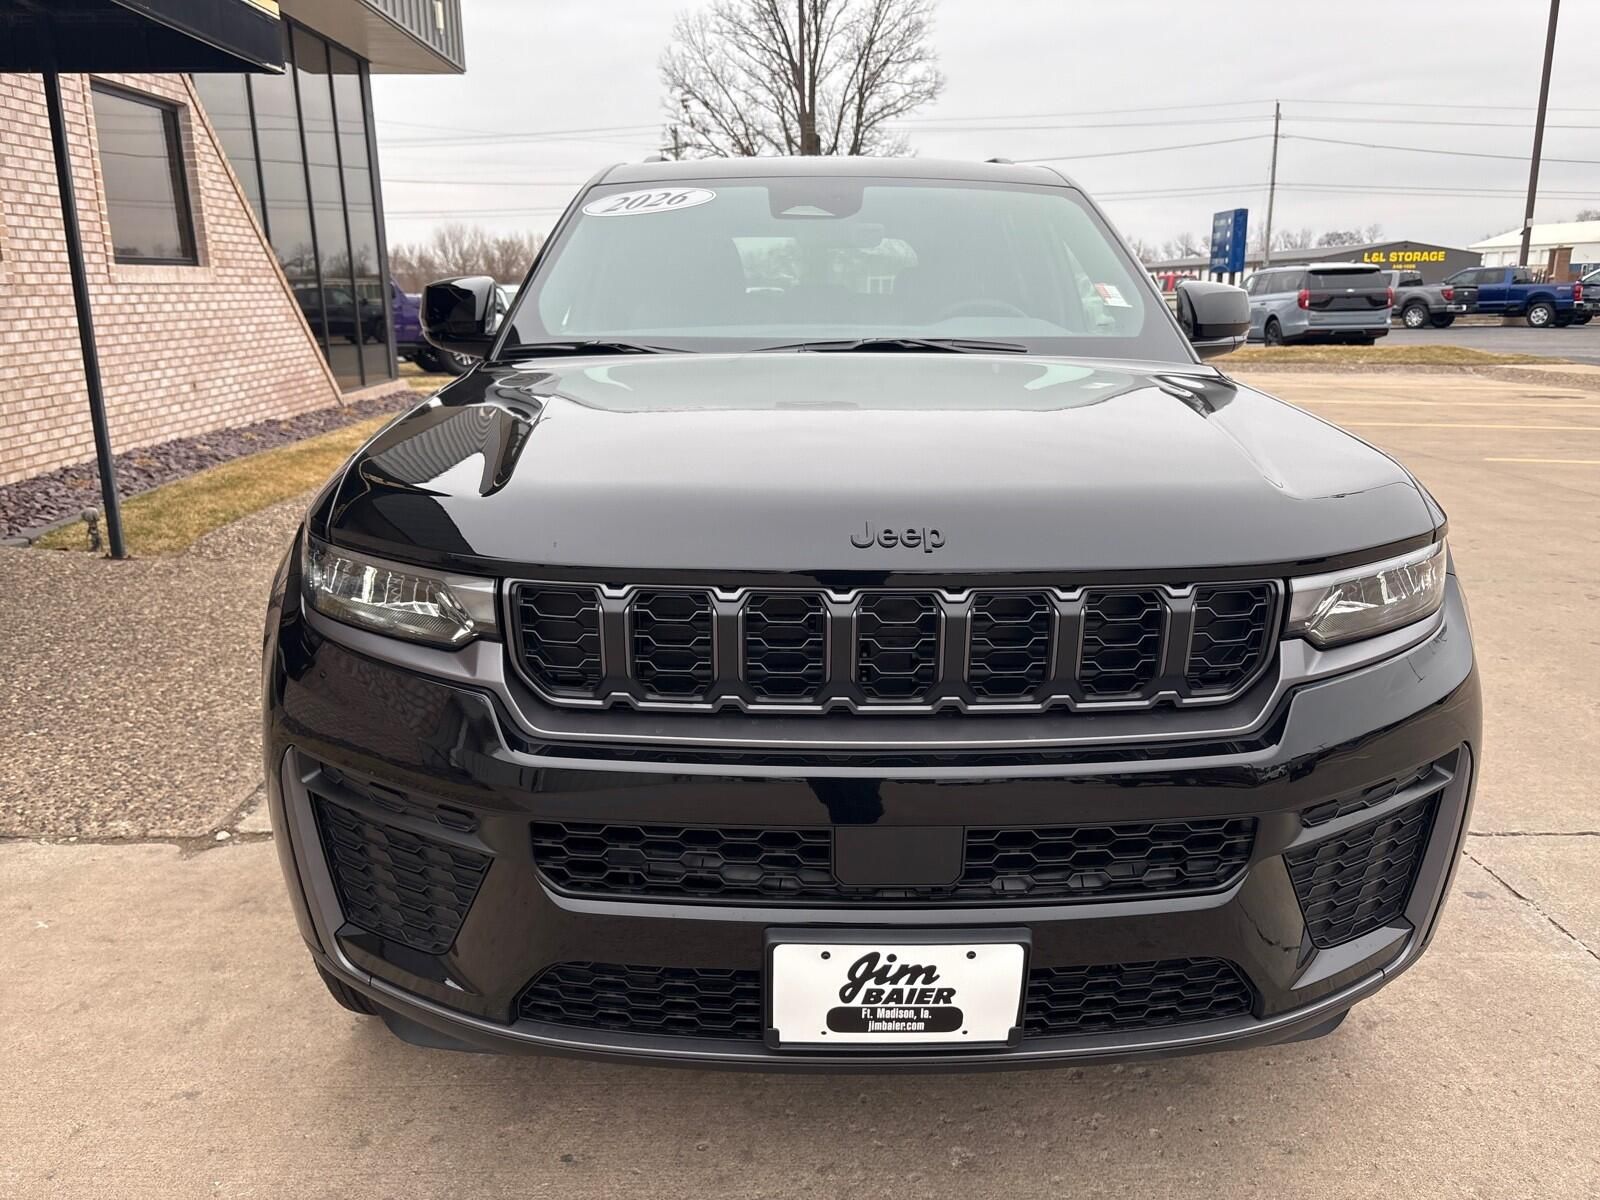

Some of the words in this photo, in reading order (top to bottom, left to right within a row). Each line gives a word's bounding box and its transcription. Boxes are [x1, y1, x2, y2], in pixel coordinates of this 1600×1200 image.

[601, 190, 697, 213] 2026
[1363, 252, 1386, 263] L&L
[1389, 251, 1446, 262] STORAGE
[850, 519, 946, 553] Jeep
[839, 951, 940, 1004] Jim
[861, 987, 956, 1005] BAIER
[861, 1008, 873, 1019] Ft.
[876, 1008, 917, 1020] Madison,
[868, 1020, 925, 1032] jimbaier.com
